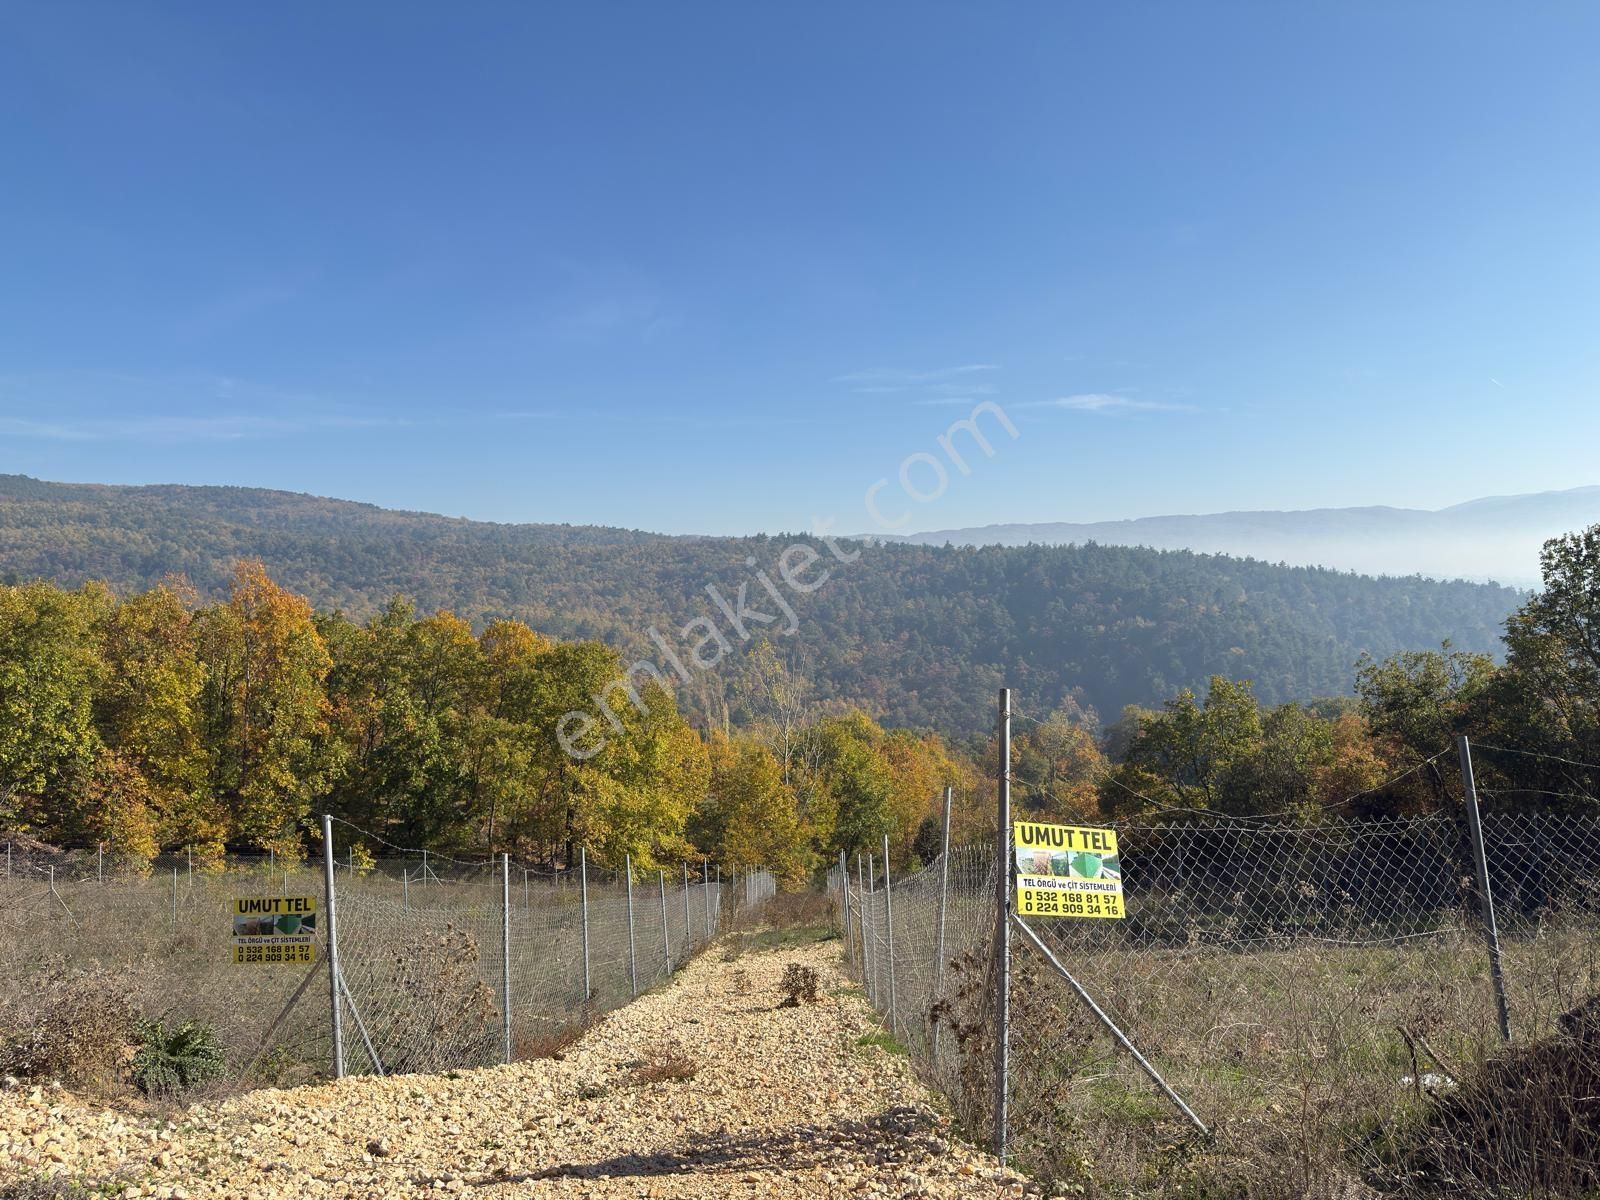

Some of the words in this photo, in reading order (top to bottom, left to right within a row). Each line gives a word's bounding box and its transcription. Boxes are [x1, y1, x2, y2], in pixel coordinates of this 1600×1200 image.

[1021, 826, 1075, 847] UMUT
[1080, 831, 1111, 850] TEL
[1038, 878, 1056, 888] ÖRGÜ
[1068, 881, 1077, 891] ÇİT
[1025, 891, 1032, 900] 0
[1036, 892, 1057, 901] 532
[1062, 894, 1082, 902] 168
[1086, 895, 1099, 903] 81
[1104, 896, 1116, 904] 57
[239, 899, 281, 913] UMUT
[286, 898, 311, 911] TEL
[1026, 902, 1032, 911] 0
[1037, 903, 1058, 912] 224
[1063, 904, 1083, 913] 909
[1087, 905, 1100, 914] 34
[1105, 906, 1118, 915] 16
